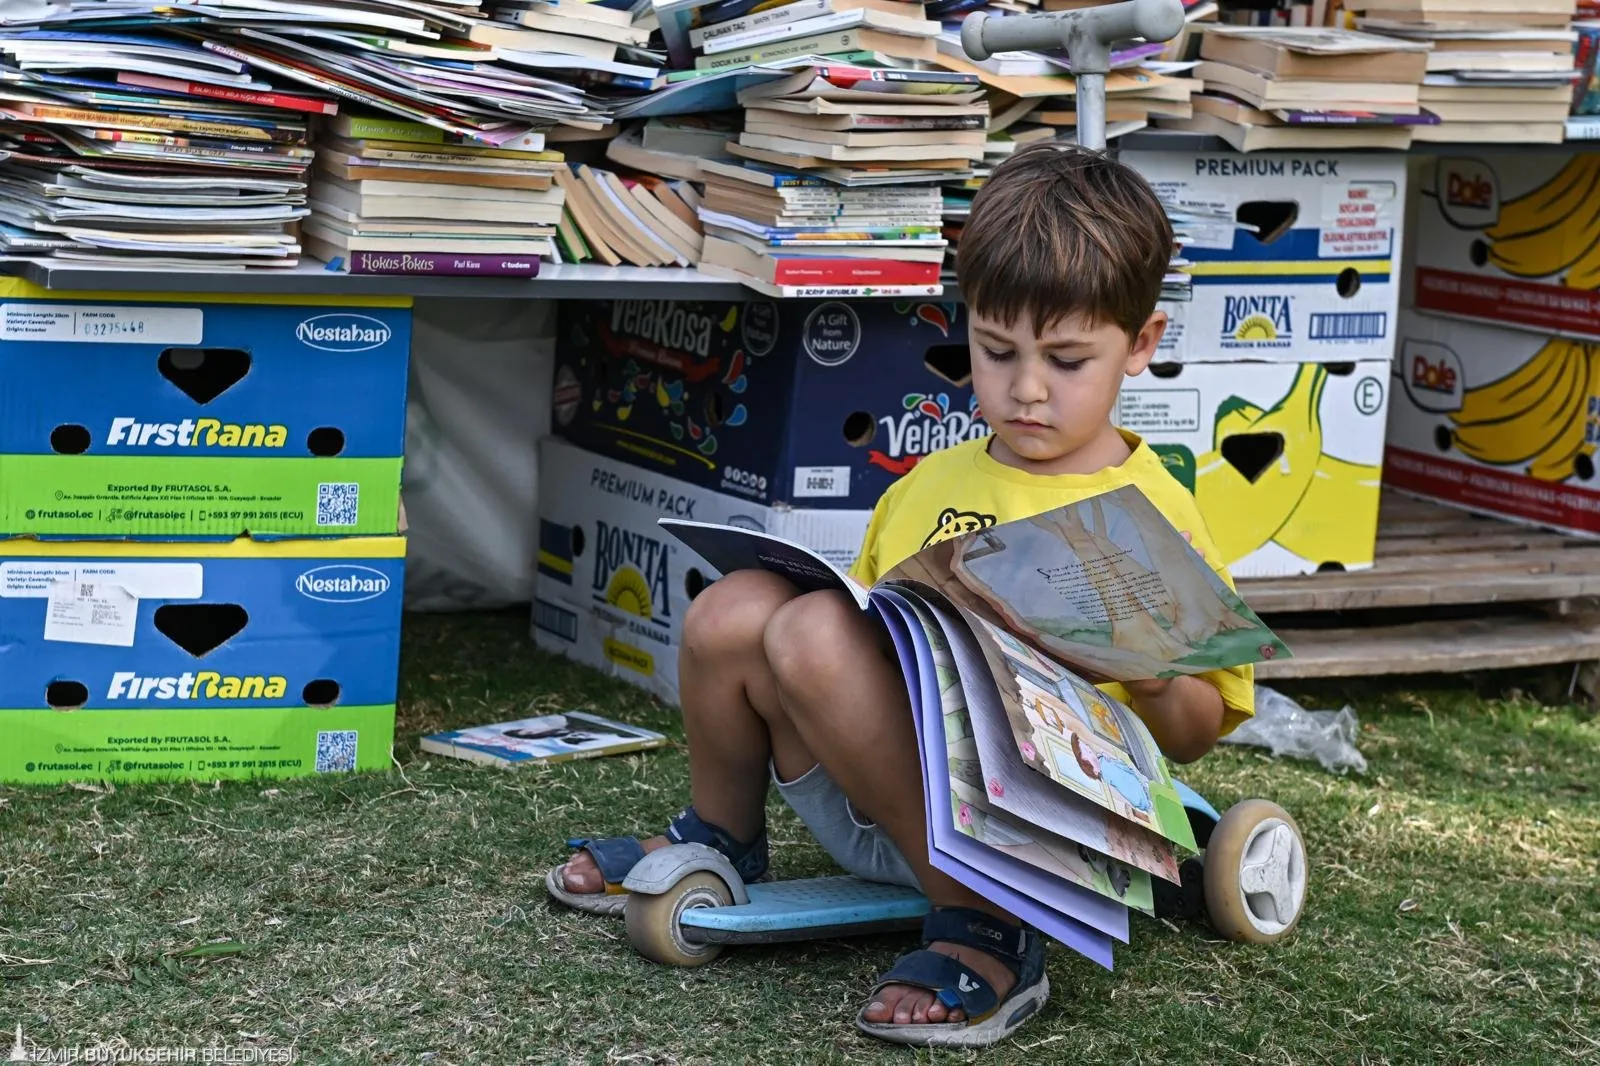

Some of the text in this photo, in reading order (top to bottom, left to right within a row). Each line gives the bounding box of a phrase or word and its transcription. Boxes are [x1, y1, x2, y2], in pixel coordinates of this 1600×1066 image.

[1195, 159, 1339, 177] PREMIUM PACK
[1448, 173, 1493, 204] Dole
[361, 253, 399, 271] Hokus
[400, 254, 434, 271] Pokus
[818, 314, 848, 326] A Gift
[1221, 295, 1290, 334] BONITA
[300, 322, 388, 343] Nestaban
[611, 300, 712, 357] VelaRosa
[811, 339, 851, 350] Nature
[1413, 355, 1456, 389] Dole
[1362, 384, 1376, 406] E
[106, 417, 288, 447] FirstBana
[878, 411, 992, 457] VelaRo
[107, 484, 148, 493] Exported
[151, 485, 162, 493] By
[591, 468, 654, 504] PREMIUM
[656, 489, 697, 519] PACK
[38, 509, 303, 520] frutasol.ec @frutasolec +593 97 991 2615 (ECU)
[592, 519, 671, 617] BONITA
[300, 574, 387, 593] Nestaban
[107, 672, 287, 700] FirstBana
[108, 736, 148, 745] Exported
[151, 737, 162, 745] By
[38, 762, 93, 771] frutasol.ec
[123, 761, 184, 771] @frutasolec
[229, 760, 239, 768] 97
[242, 760, 256, 768] 991
[279, 759, 302, 768] (ECU)
